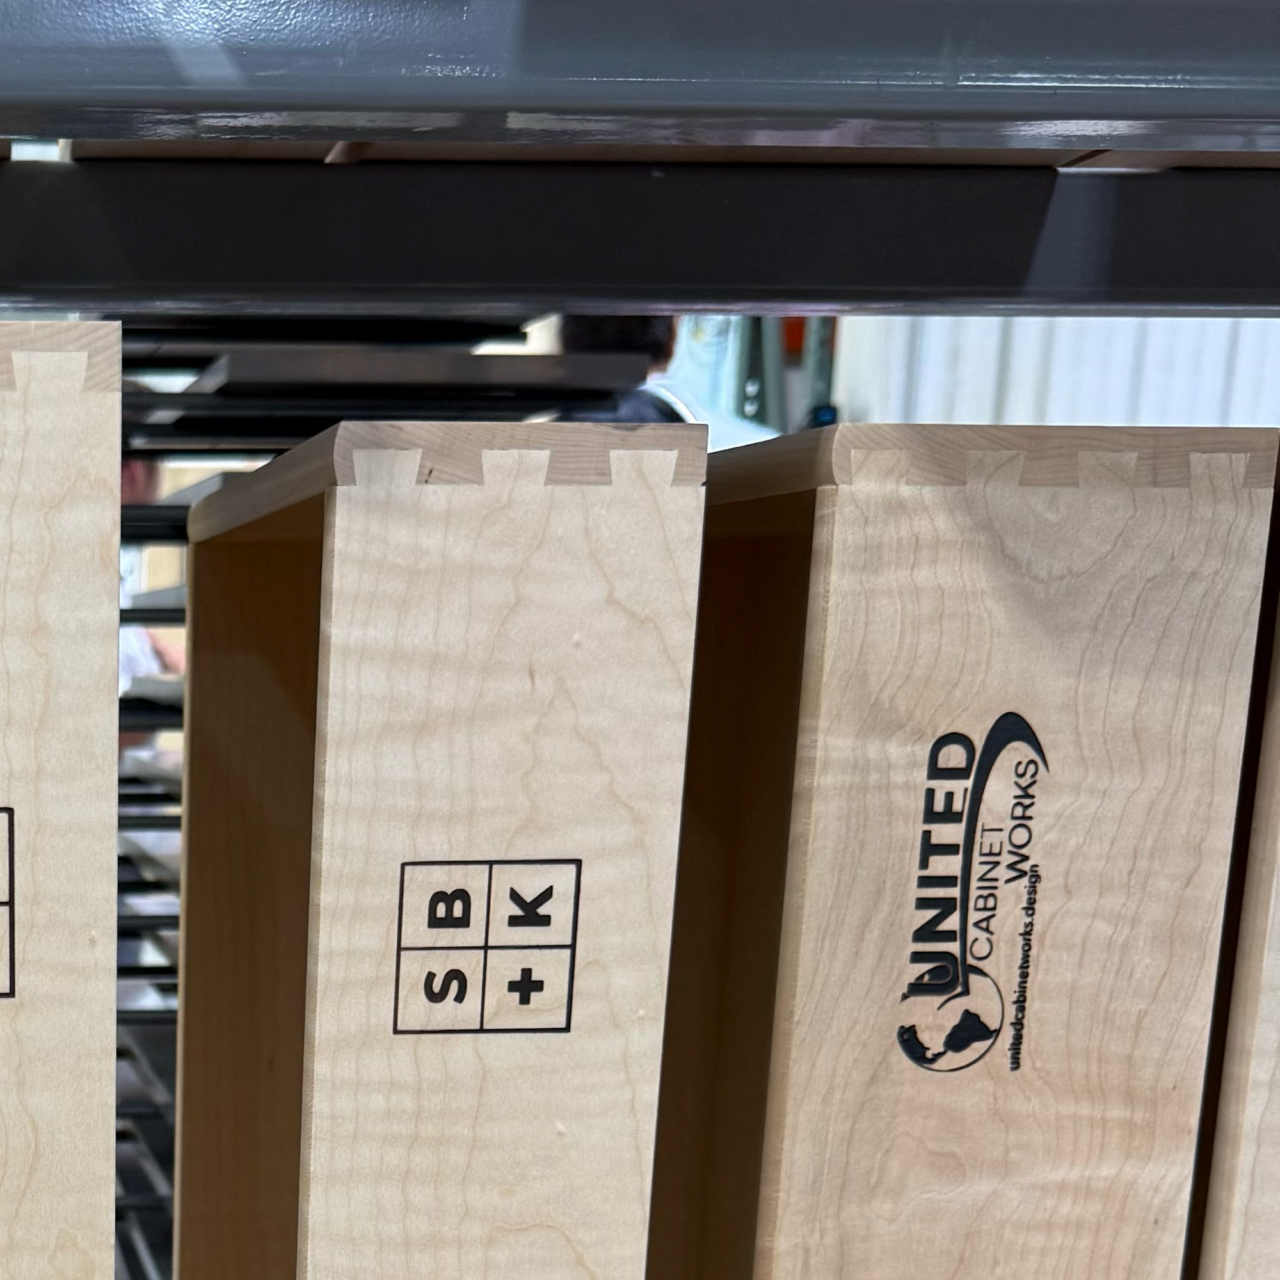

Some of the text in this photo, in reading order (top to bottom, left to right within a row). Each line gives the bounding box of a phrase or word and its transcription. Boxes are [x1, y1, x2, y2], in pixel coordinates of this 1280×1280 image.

[906, 731, 976, 997] UNITED
[968, 822, 1005, 962] CABINET
[1003, 758, 1039, 885] WORKS
[1009, 863, 1043, 1073] unitedcabinetworks.design
